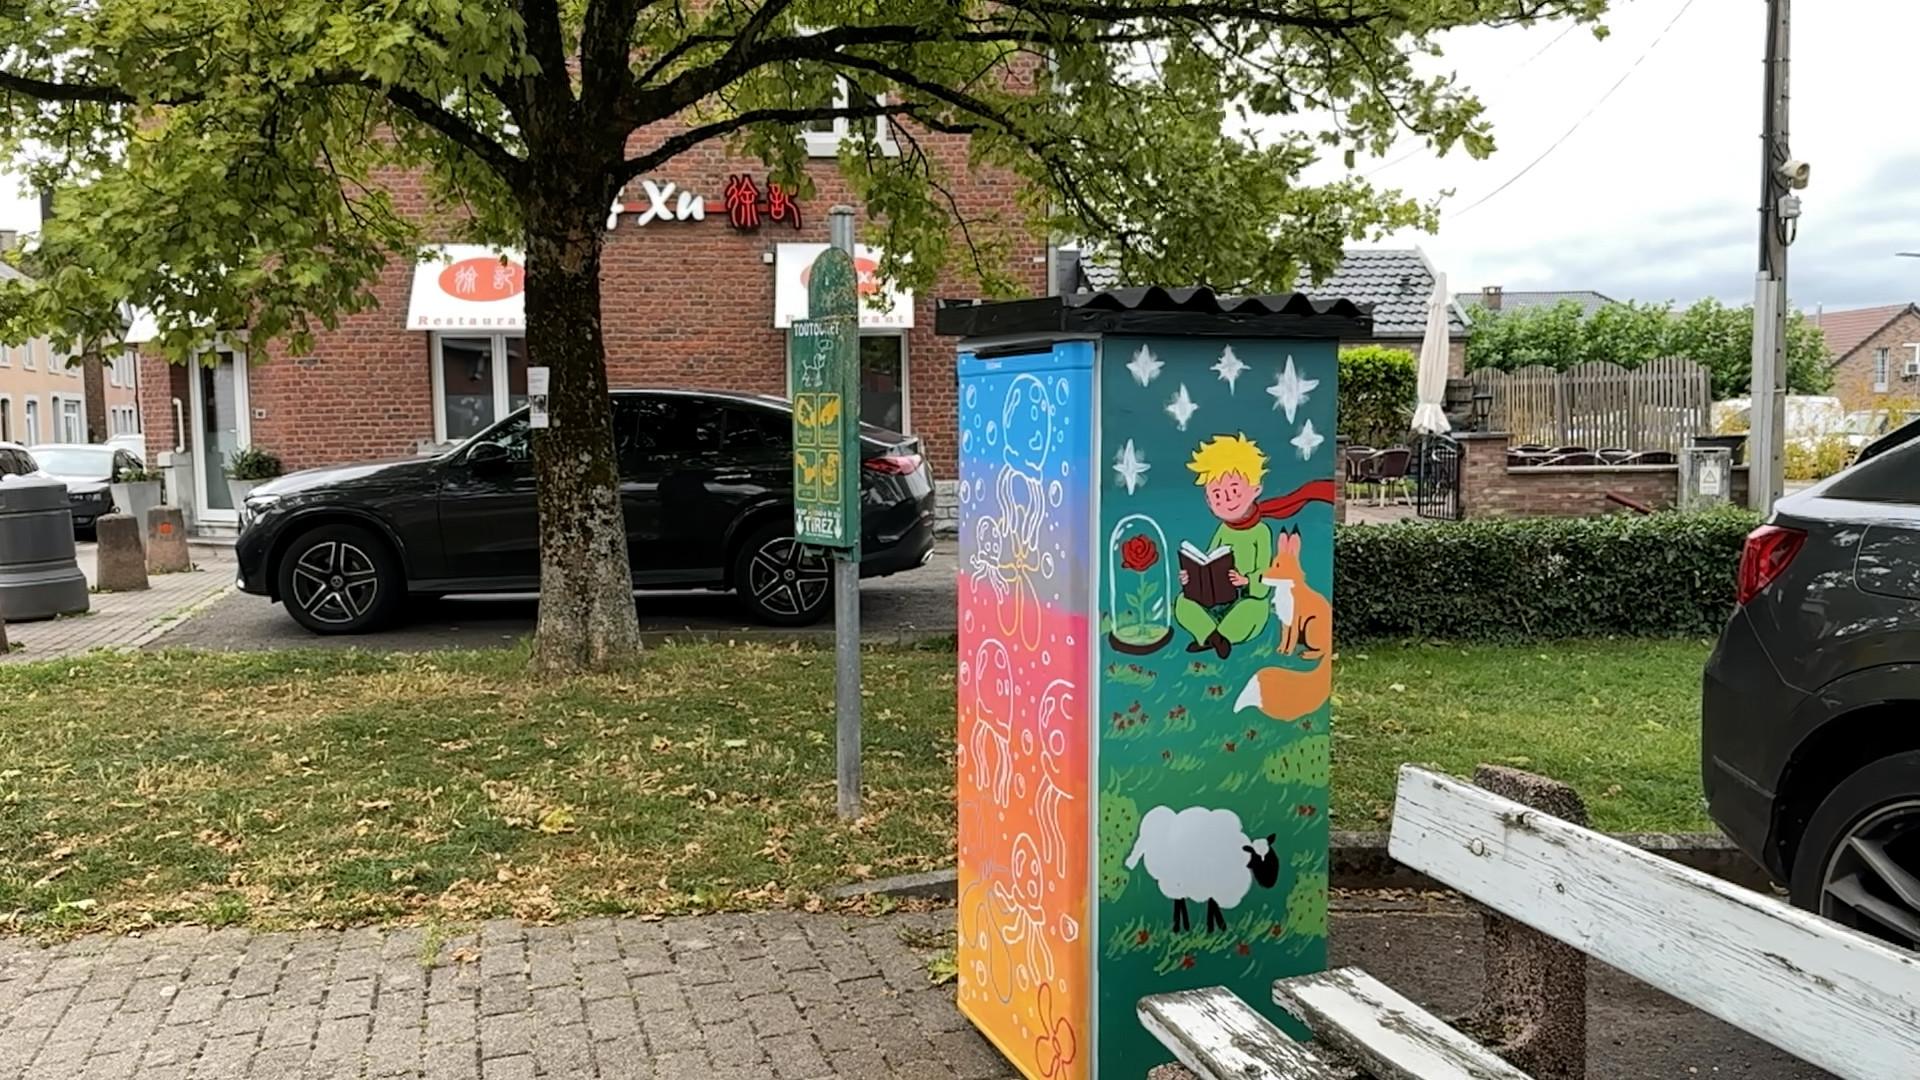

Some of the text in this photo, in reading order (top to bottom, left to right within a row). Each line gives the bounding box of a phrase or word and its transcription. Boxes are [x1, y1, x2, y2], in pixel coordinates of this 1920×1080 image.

[638, 180, 705, 226] Xu
[418, 315, 525, 326] Restaura
[803, 516, 834, 534] TIREZ
